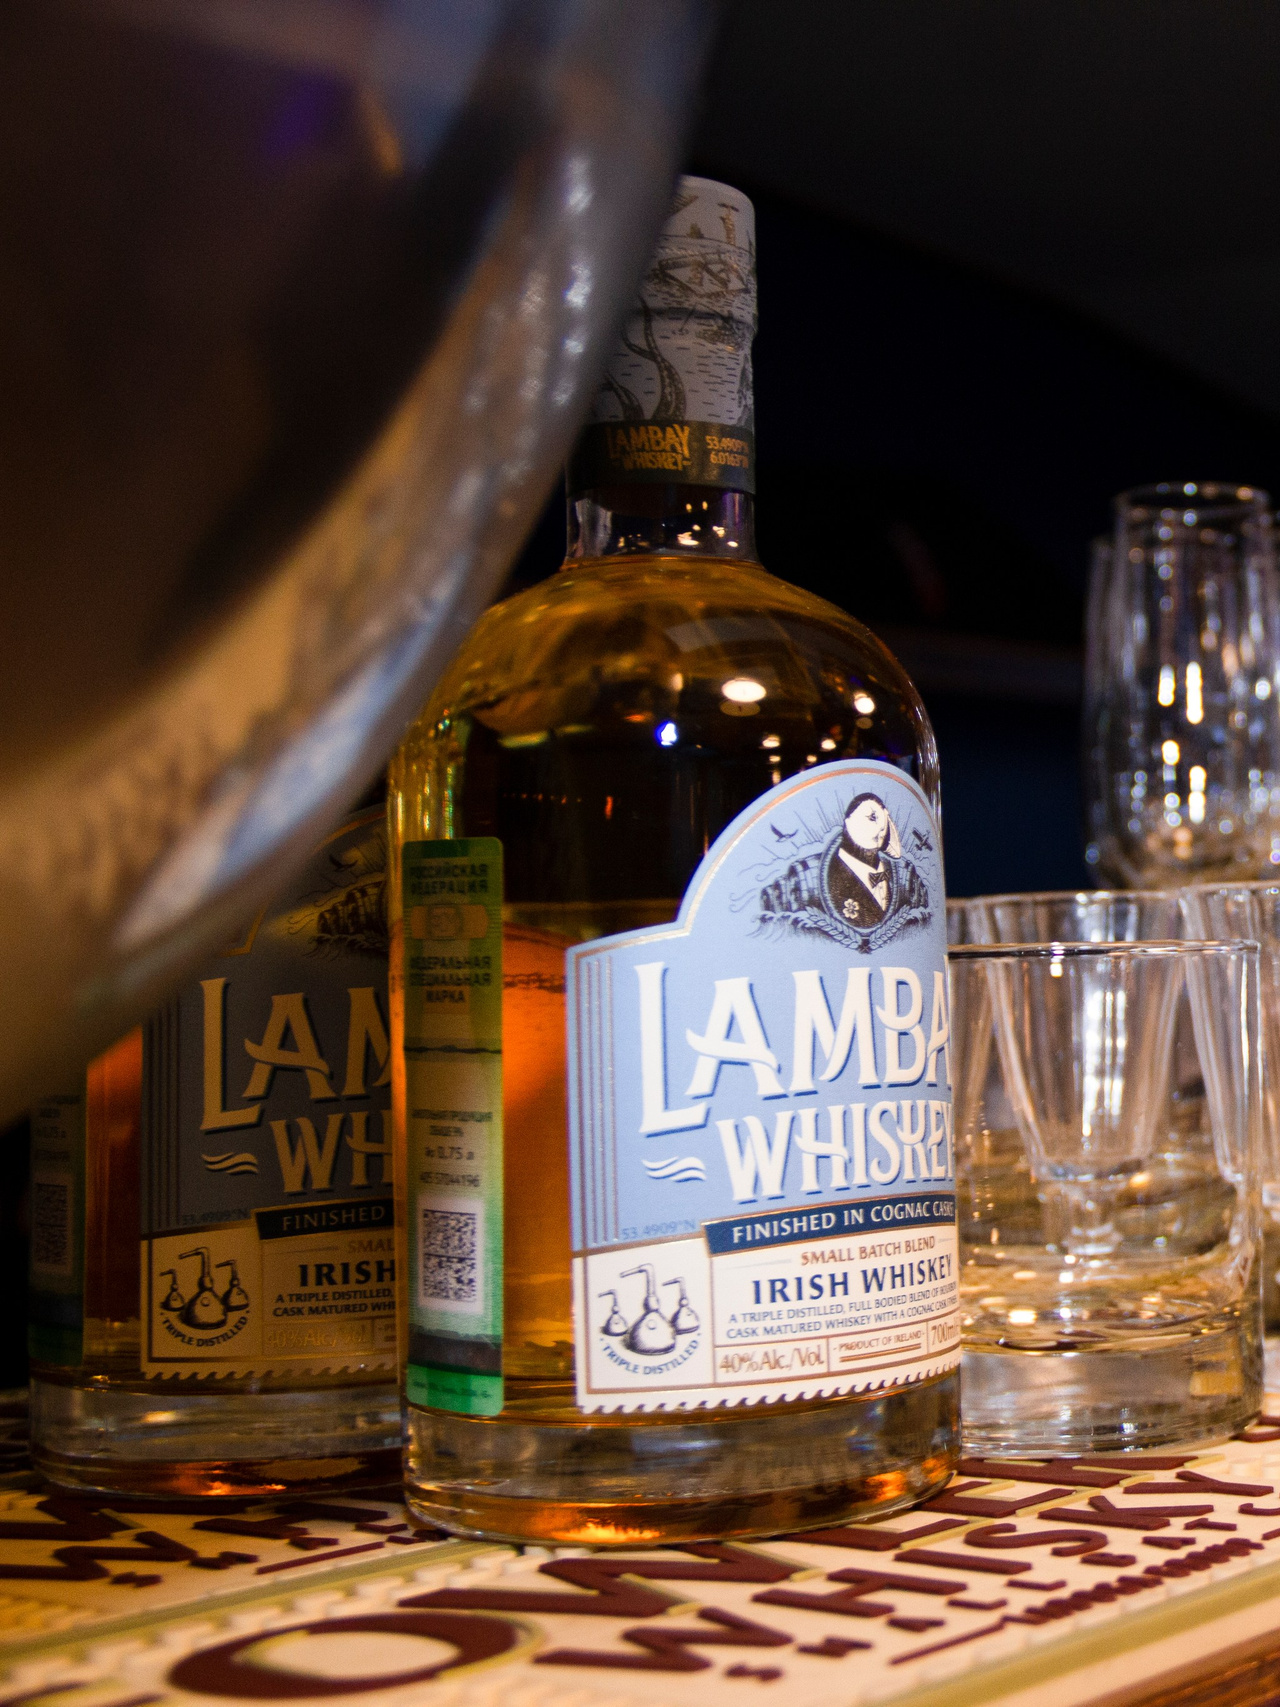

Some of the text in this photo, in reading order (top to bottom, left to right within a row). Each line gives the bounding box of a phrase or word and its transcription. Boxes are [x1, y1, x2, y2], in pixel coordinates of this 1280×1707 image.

[633, 955, 952, 1137] LAMBA
[283, 1205, 386, 1232] FINISHED
[732, 1213, 836, 1244] FINISHED
[843, 1209, 864, 1227] IN
[870, 1202, 930, 1223] COGNAC
[349, 1238, 394, 1253] SMAL
[801, 1235, 936, 1266] SMALL BATCH BLEND
[299, 1259, 395, 1287] IRISH
[752, 1253, 952, 1305] IRISH WHISKEY
[272, 1306, 304, 1317] CASK
[307, 1302, 368, 1316] MATURED
[275, 1294, 285, 1304] A
[288, 1291, 328, 1303] TRIPLE
[728, 1313, 738, 1324] A
[741, 1309, 783, 1323] TRIPLE
[786, 1303, 846, 1319] DISTILLED,
[849, 1299, 873, 1312] FULL
[874, 1293, 907, 1310] BODIED
[908, 1289, 930, 1305] BLEND
[160, 1315, 249, 1348] TRIPLE DISTILLED
[726, 1327, 759, 1339] CASK
[763, 1320, 823, 1336] MATURED
[826, 1314, 871, 1330] WHISKEY
[873, 1310, 898, 1325] WITH
[899, 1308, 906, 1319] A
[906, 1302, 934, 1318] COGNAC
[602, 1339, 699, 1376] TRIPLE DISTILLED
[838, 1331, 923, 1352] PRODUCT OF IRELAND
[532, 1470, 1275, 1673] WHISKY
